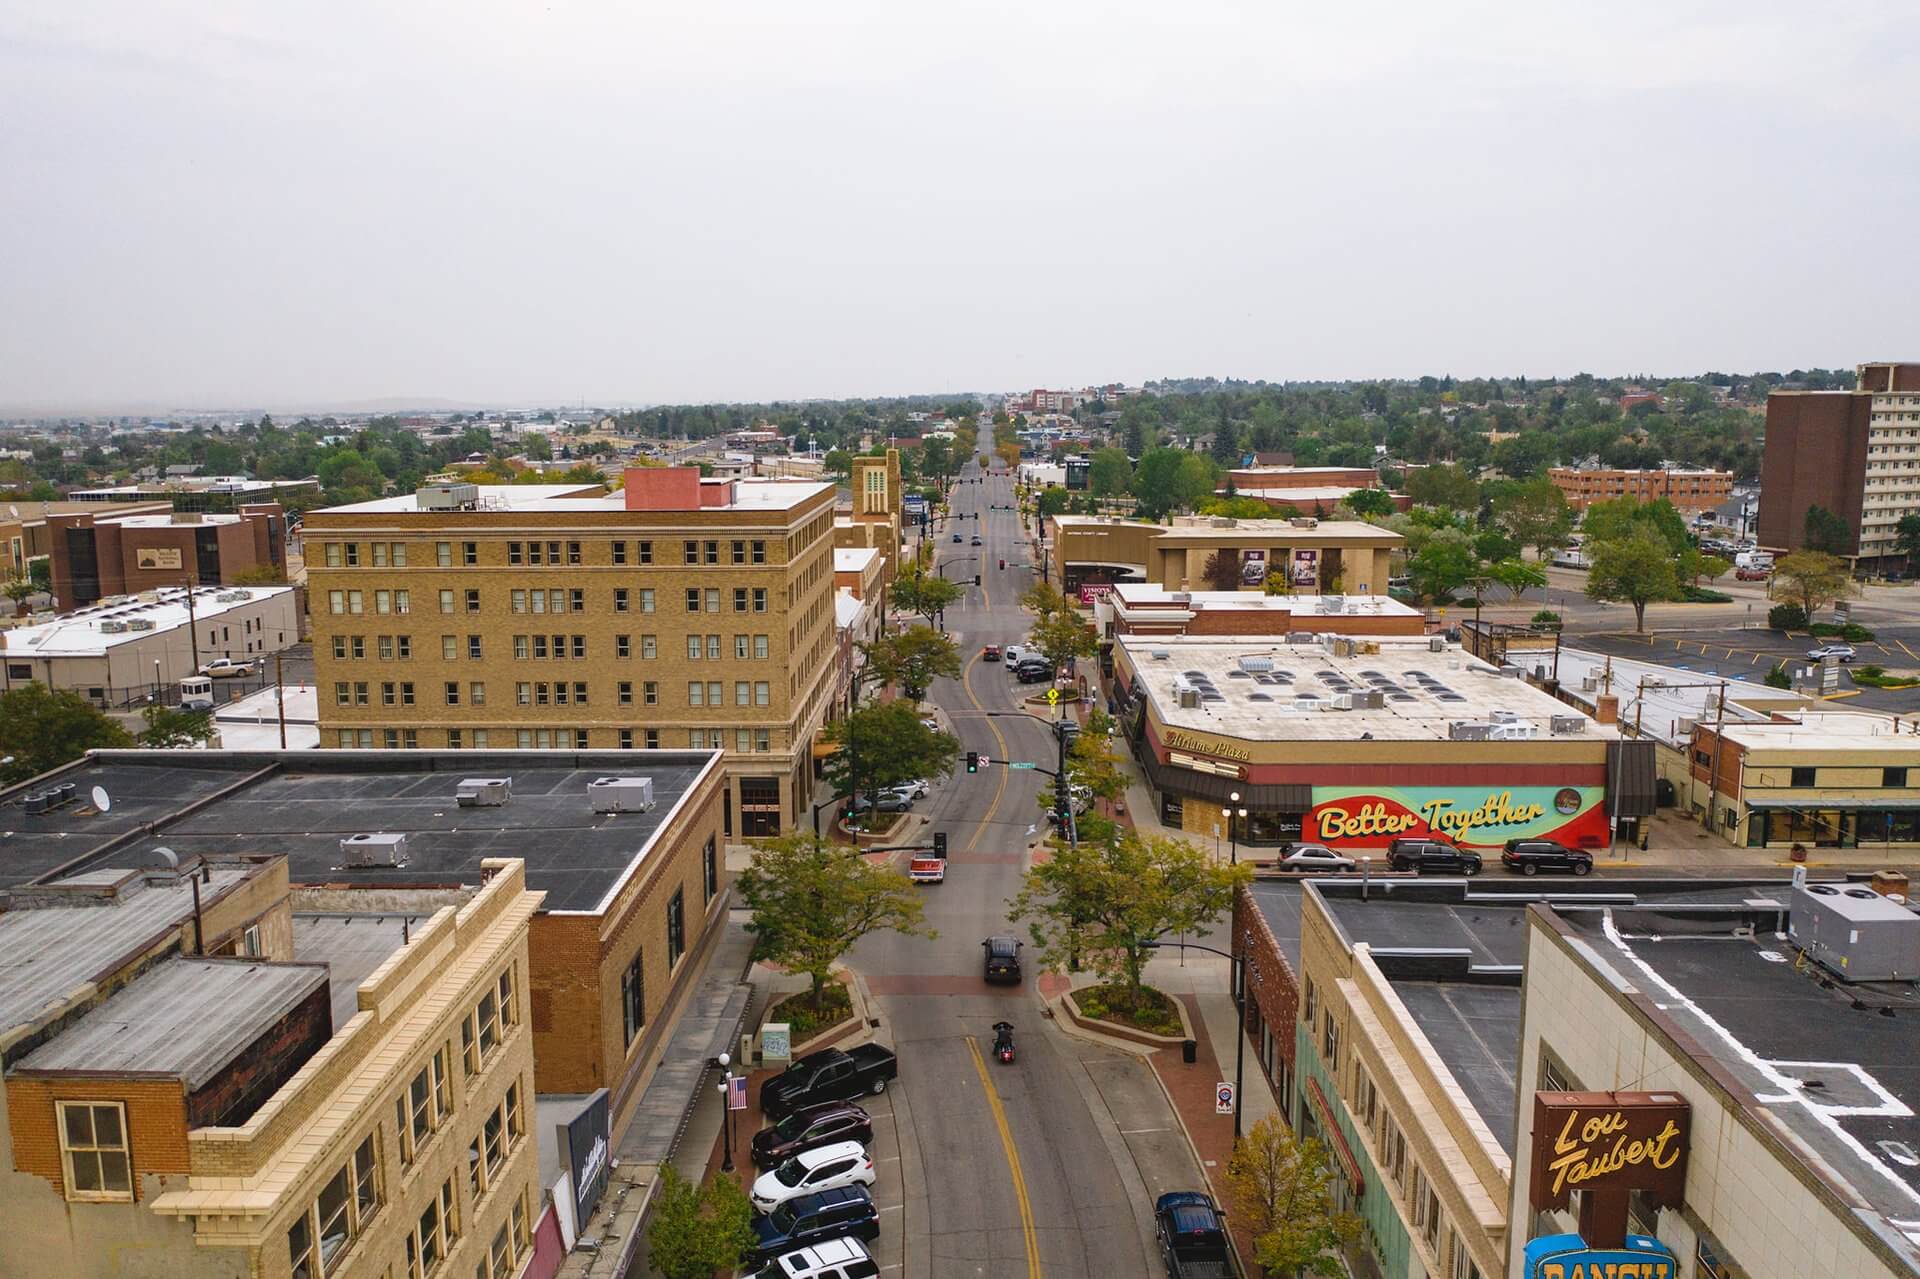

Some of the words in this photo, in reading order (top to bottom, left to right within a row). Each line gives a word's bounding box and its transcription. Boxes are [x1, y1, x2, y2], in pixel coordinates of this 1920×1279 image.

[1316, 802, 1418, 840] Better
[1423, 791, 1546, 843] Together
[1548, 1119, 1681, 1198] Taubert
[1554, 1110, 1629, 1155] Lou
